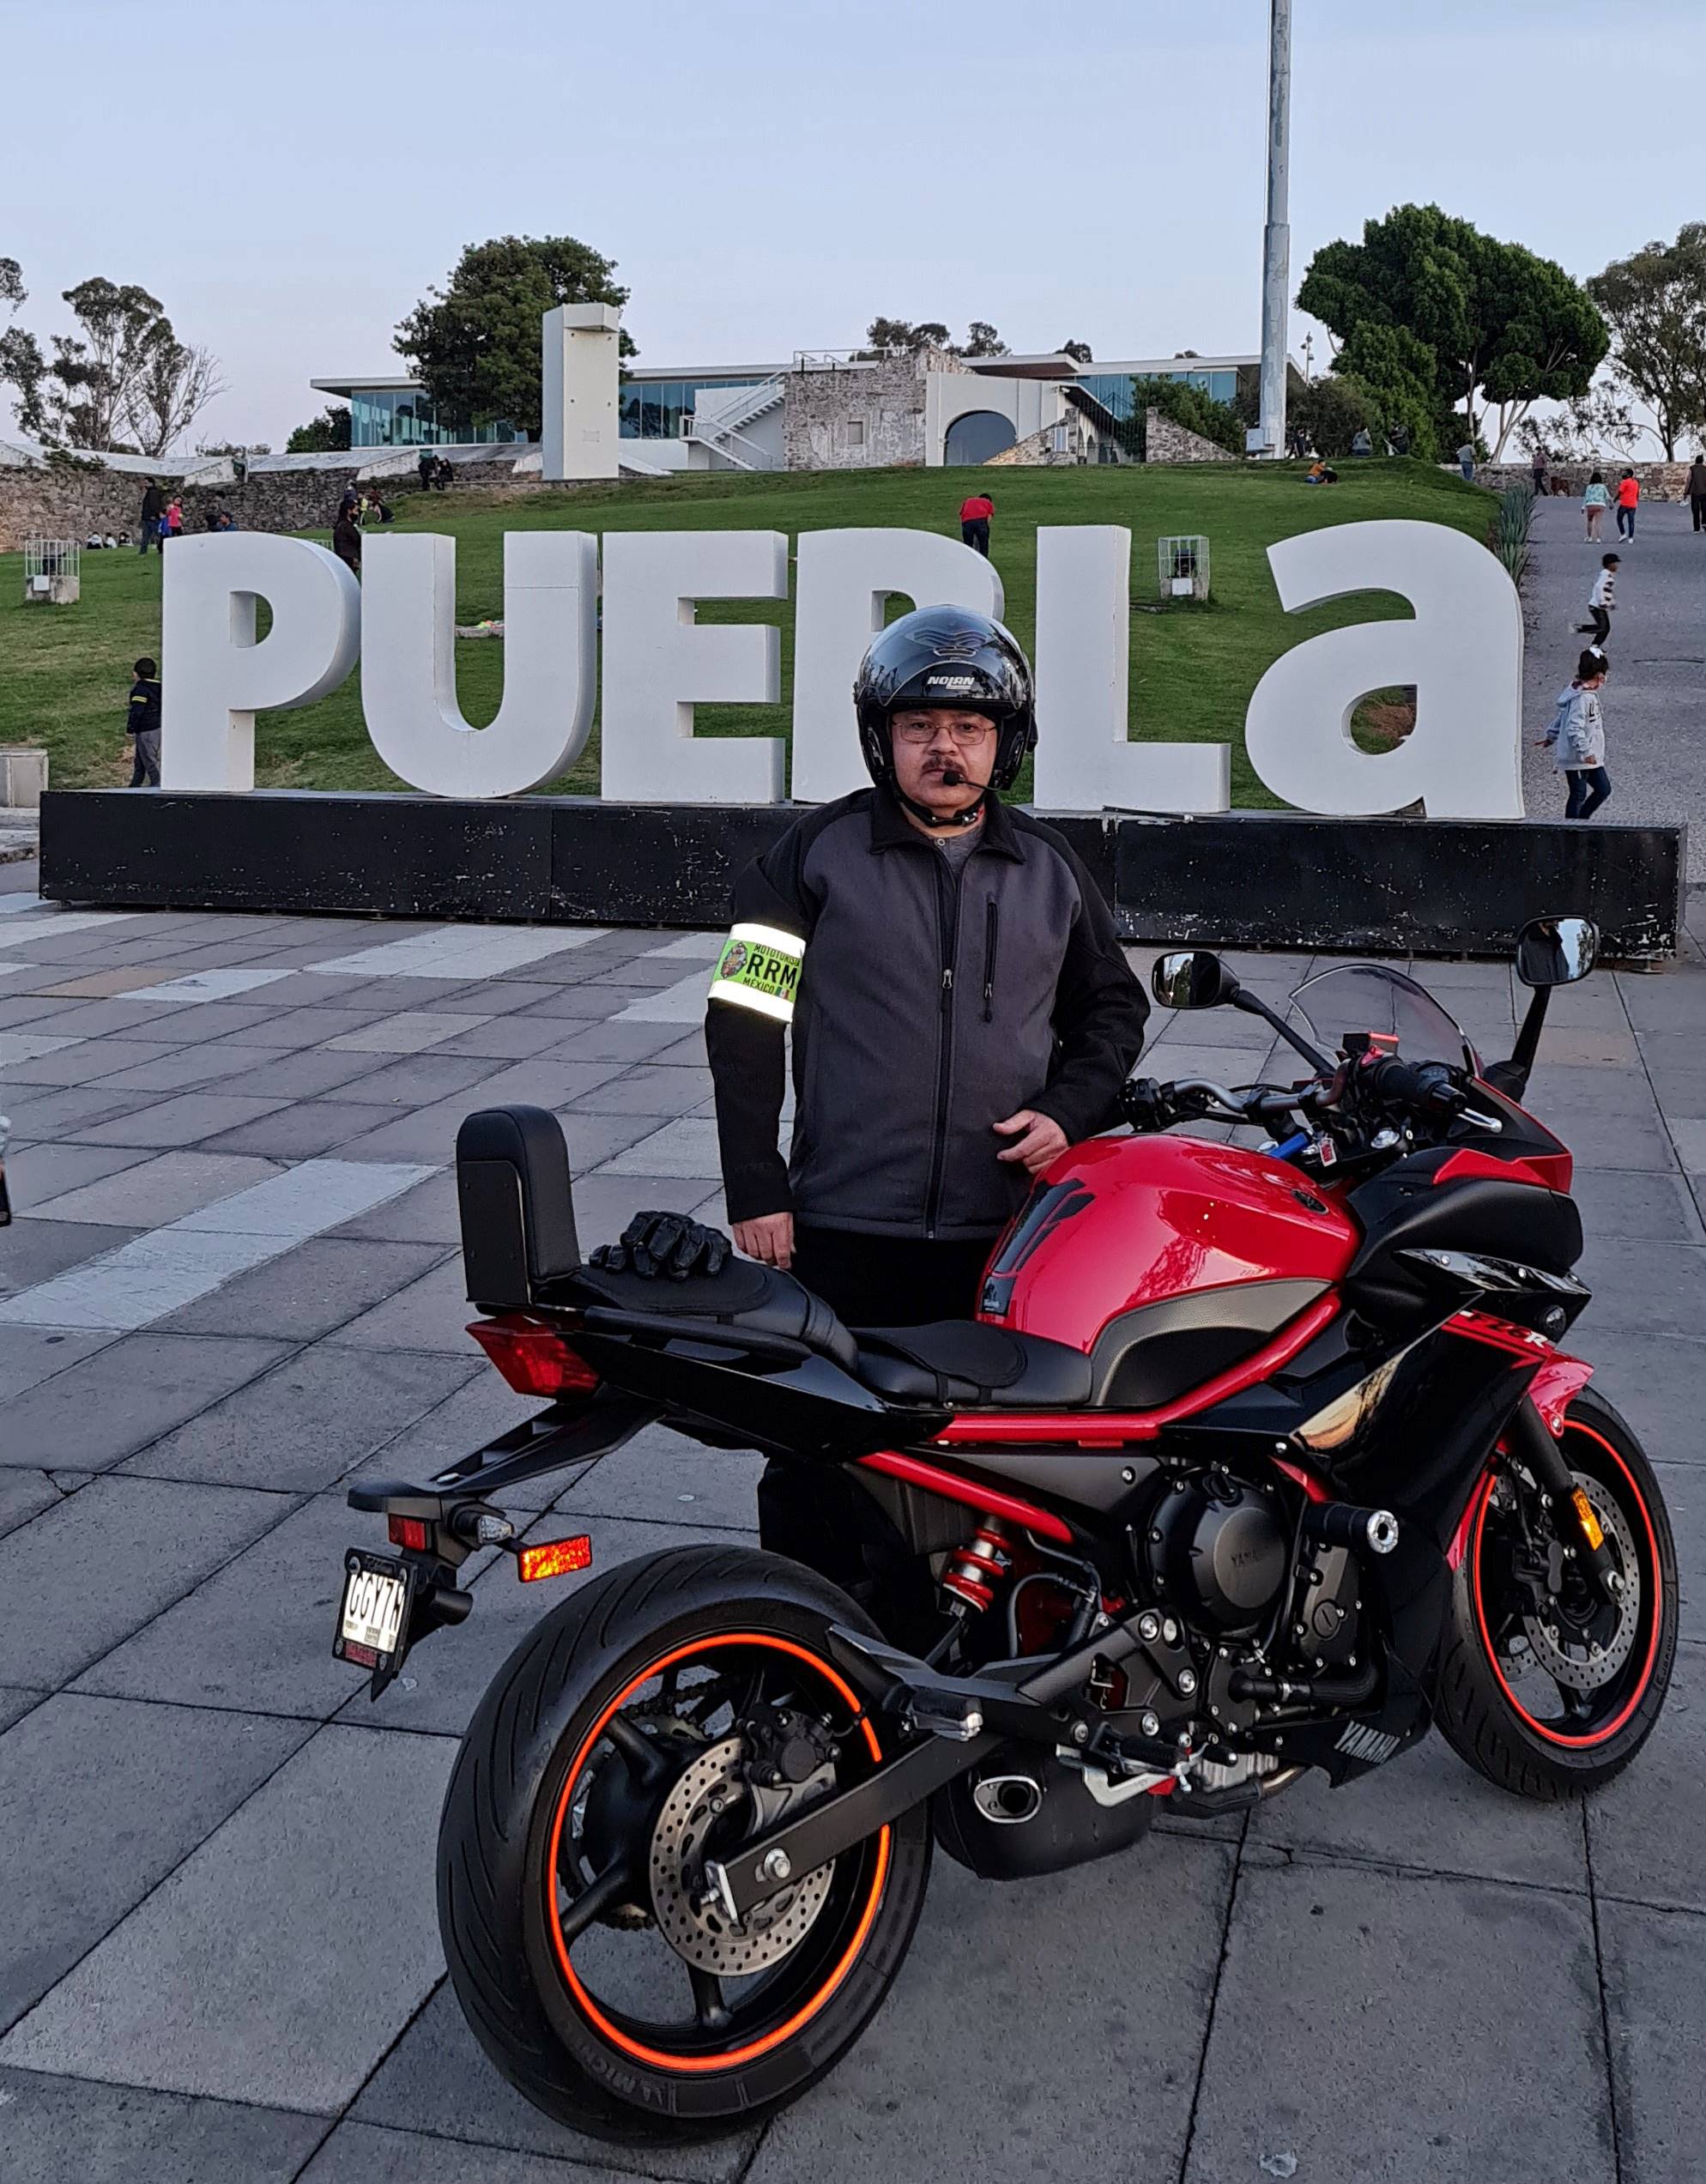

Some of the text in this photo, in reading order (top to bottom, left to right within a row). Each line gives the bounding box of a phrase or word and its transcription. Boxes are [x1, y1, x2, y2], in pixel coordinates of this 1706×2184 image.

[927, 676, 975, 690] NOLAN
[746, 953, 797, 989] RRM
[1334, 1720, 1400, 1764] YAMAHA
